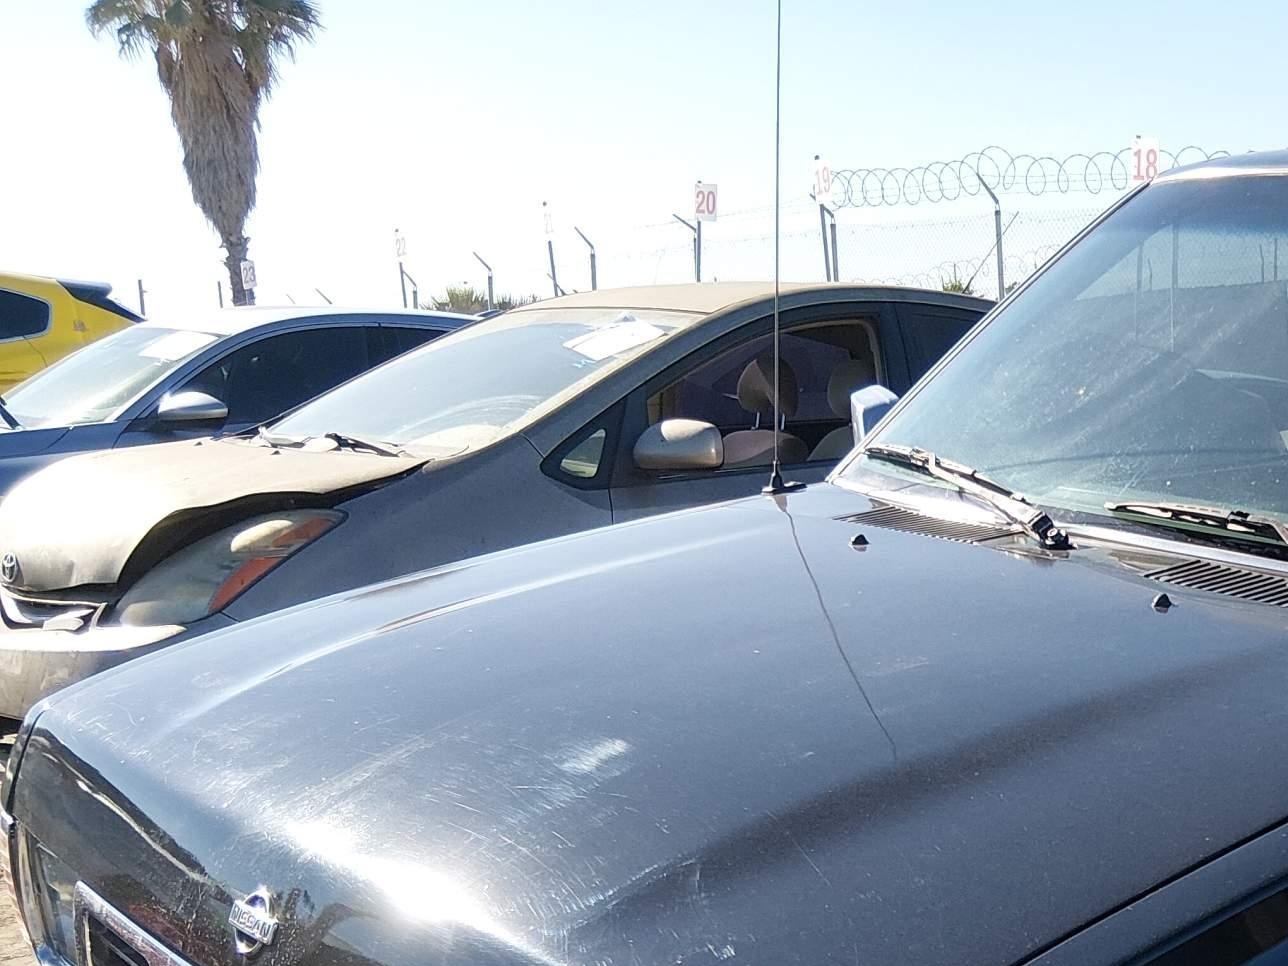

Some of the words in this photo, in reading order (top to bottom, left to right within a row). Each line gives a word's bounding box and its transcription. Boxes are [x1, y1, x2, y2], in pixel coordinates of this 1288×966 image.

[1133, 149, 1157, 180] 18
[815, 166, 831, 195] 19
[695, 190, 716, 214] 20
[395, 237, 407, 257] 22
[242, 266, 256, 284] 23
[230, 904, 272, 938] NISSAN
